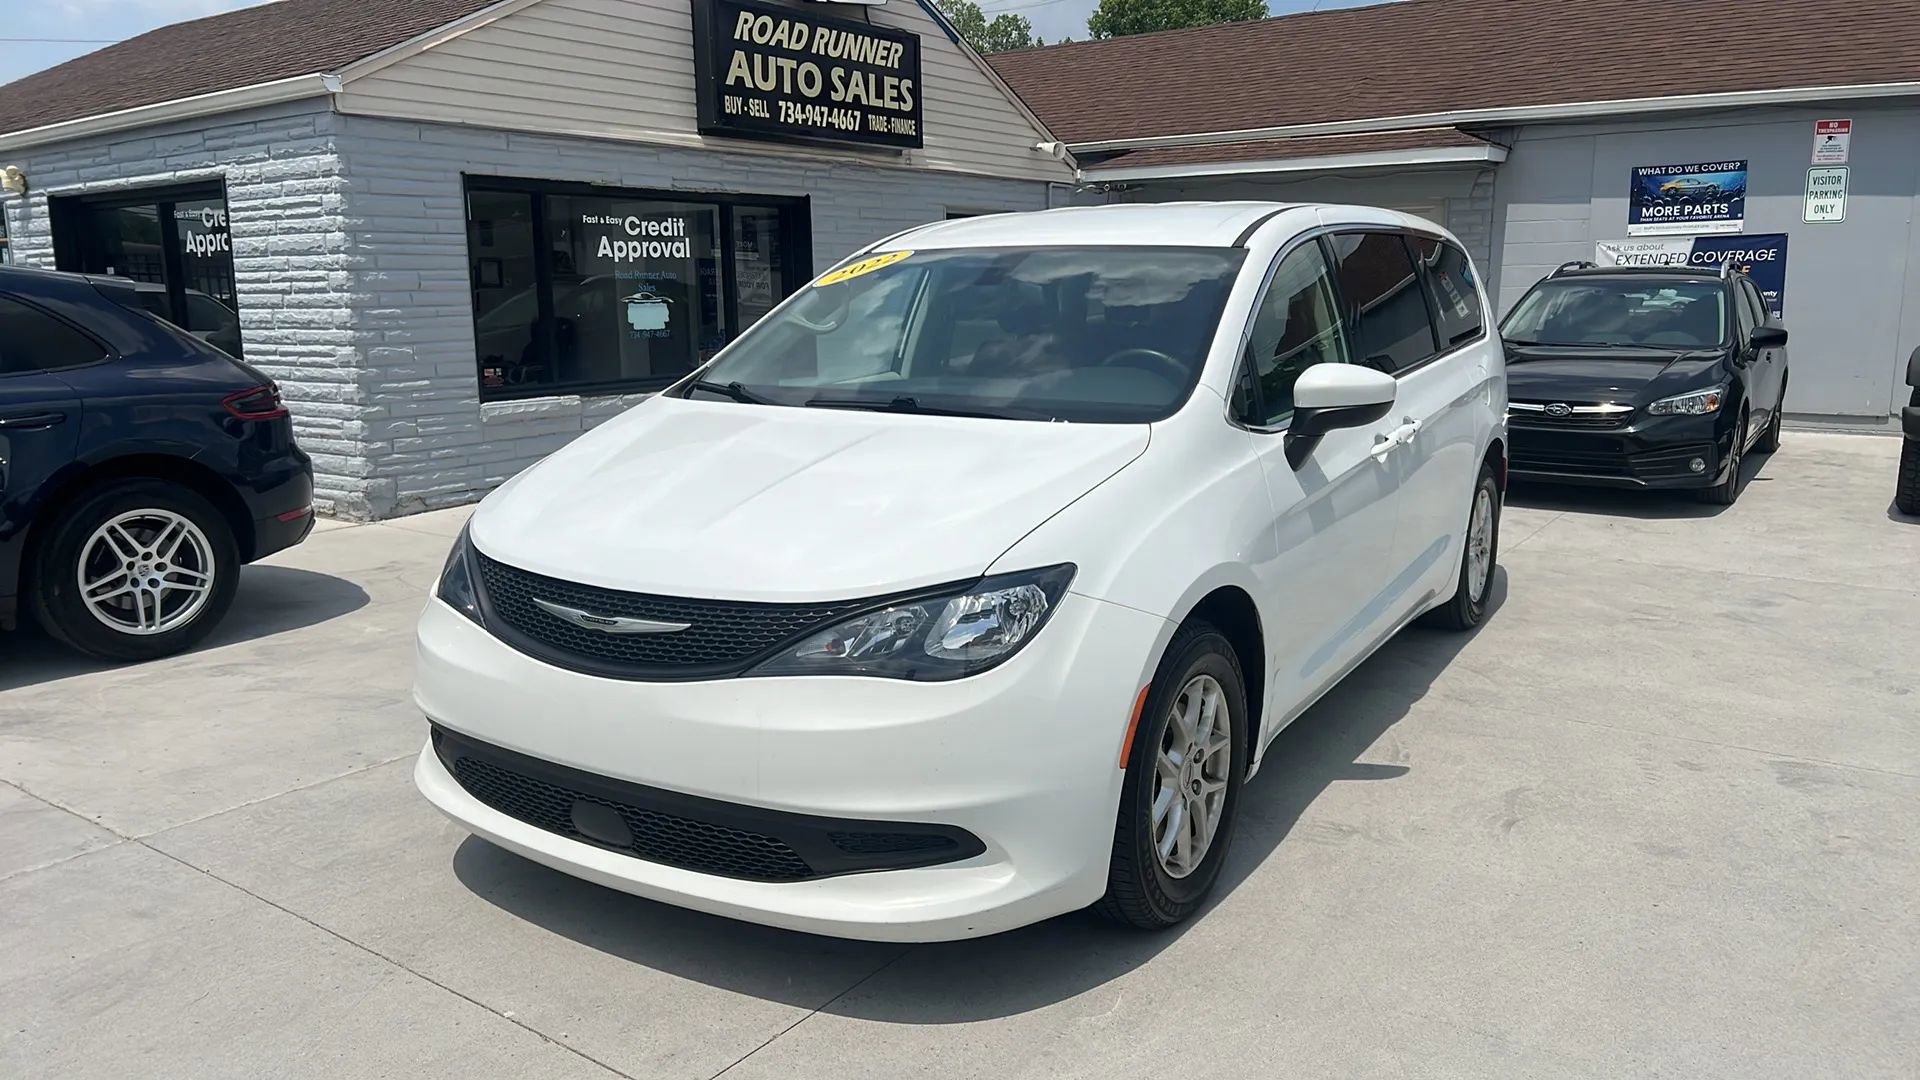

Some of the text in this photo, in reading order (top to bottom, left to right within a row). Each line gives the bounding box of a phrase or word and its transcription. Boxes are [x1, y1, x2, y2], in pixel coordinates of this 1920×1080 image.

[733, 10, 904, 69] ROAD RUNNER
[725, 49, 914, 112] AUTO SALES
[724, 95, 743, 115] BUY
[748, 98, 770, 119] SELL
[778, 100, 861, 132] 734-947-4667
[867, 113, 888, 133] TRADE
[890, 116, 916, 136] FINANCE
[1638, 162, 1740, 176] WHAT DO WE COVER?
[1812, 175, 1842, 186] VISITOR
[1808, 189, 1843, 200] PARKING
[1641, 203, 1729, 217] MORE PARTS
[1813, 203, 1836, 214] ONLY
[582, 214, 685, 237] Fast & Easy Credit
[597, 235, 691, 263] Approval
[1606, 244, 1621, 252] Ask
[1636, 243, 1664, 252] about
[1615, 248, 1778, 266] EXTENDED COVERAGE
[830, 254, 898, 282] 2022
[638, 282, 657, 292] Sales
